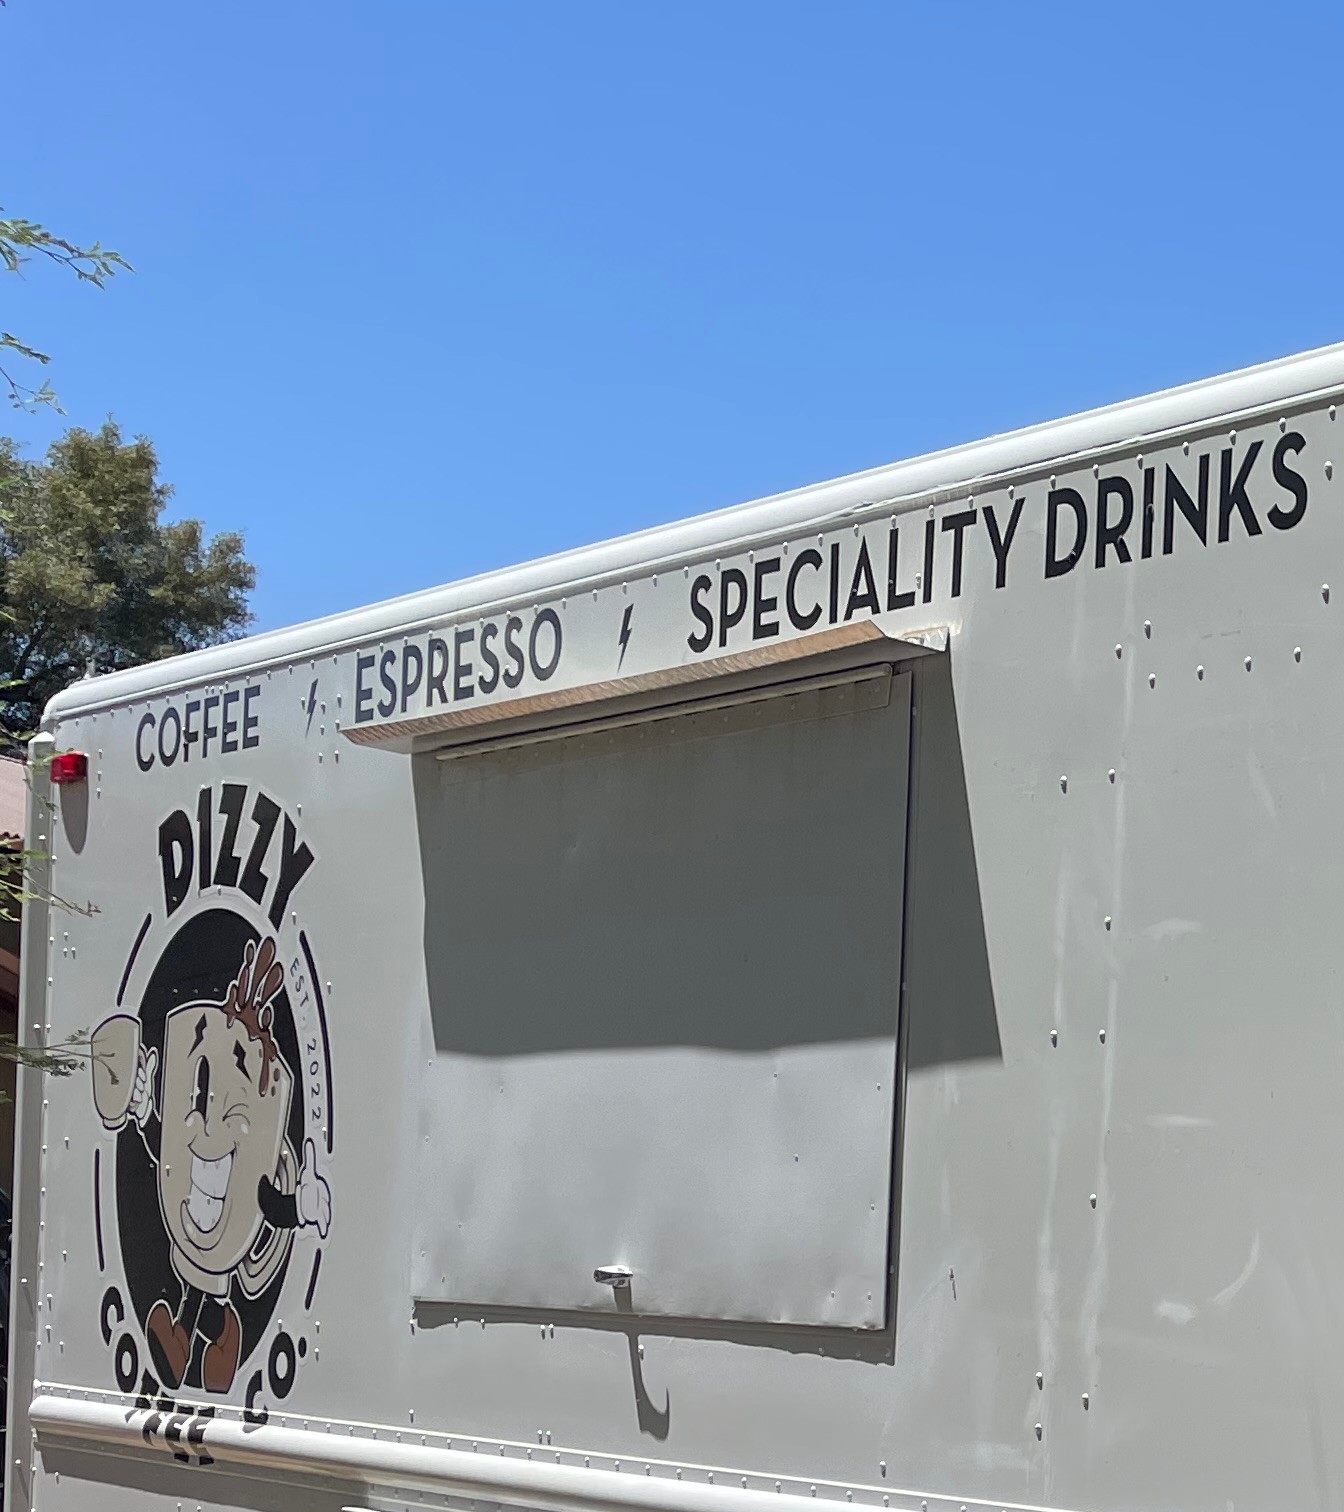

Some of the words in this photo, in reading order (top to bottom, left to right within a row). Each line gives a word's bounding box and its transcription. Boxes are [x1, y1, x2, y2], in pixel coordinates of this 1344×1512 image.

[135, 684, 262, 773] COFFEE
[354, 607, 563, 724] ESPRESSO
[686, 496, 1027, 654] SPECIALITY
[1044, 431, 1309, 580] DRINKS
[158, 783, 316, 933] DIZZY
[289, 956, 310, 1022] EST.
[306, 1037, 322, 1121] 2022
